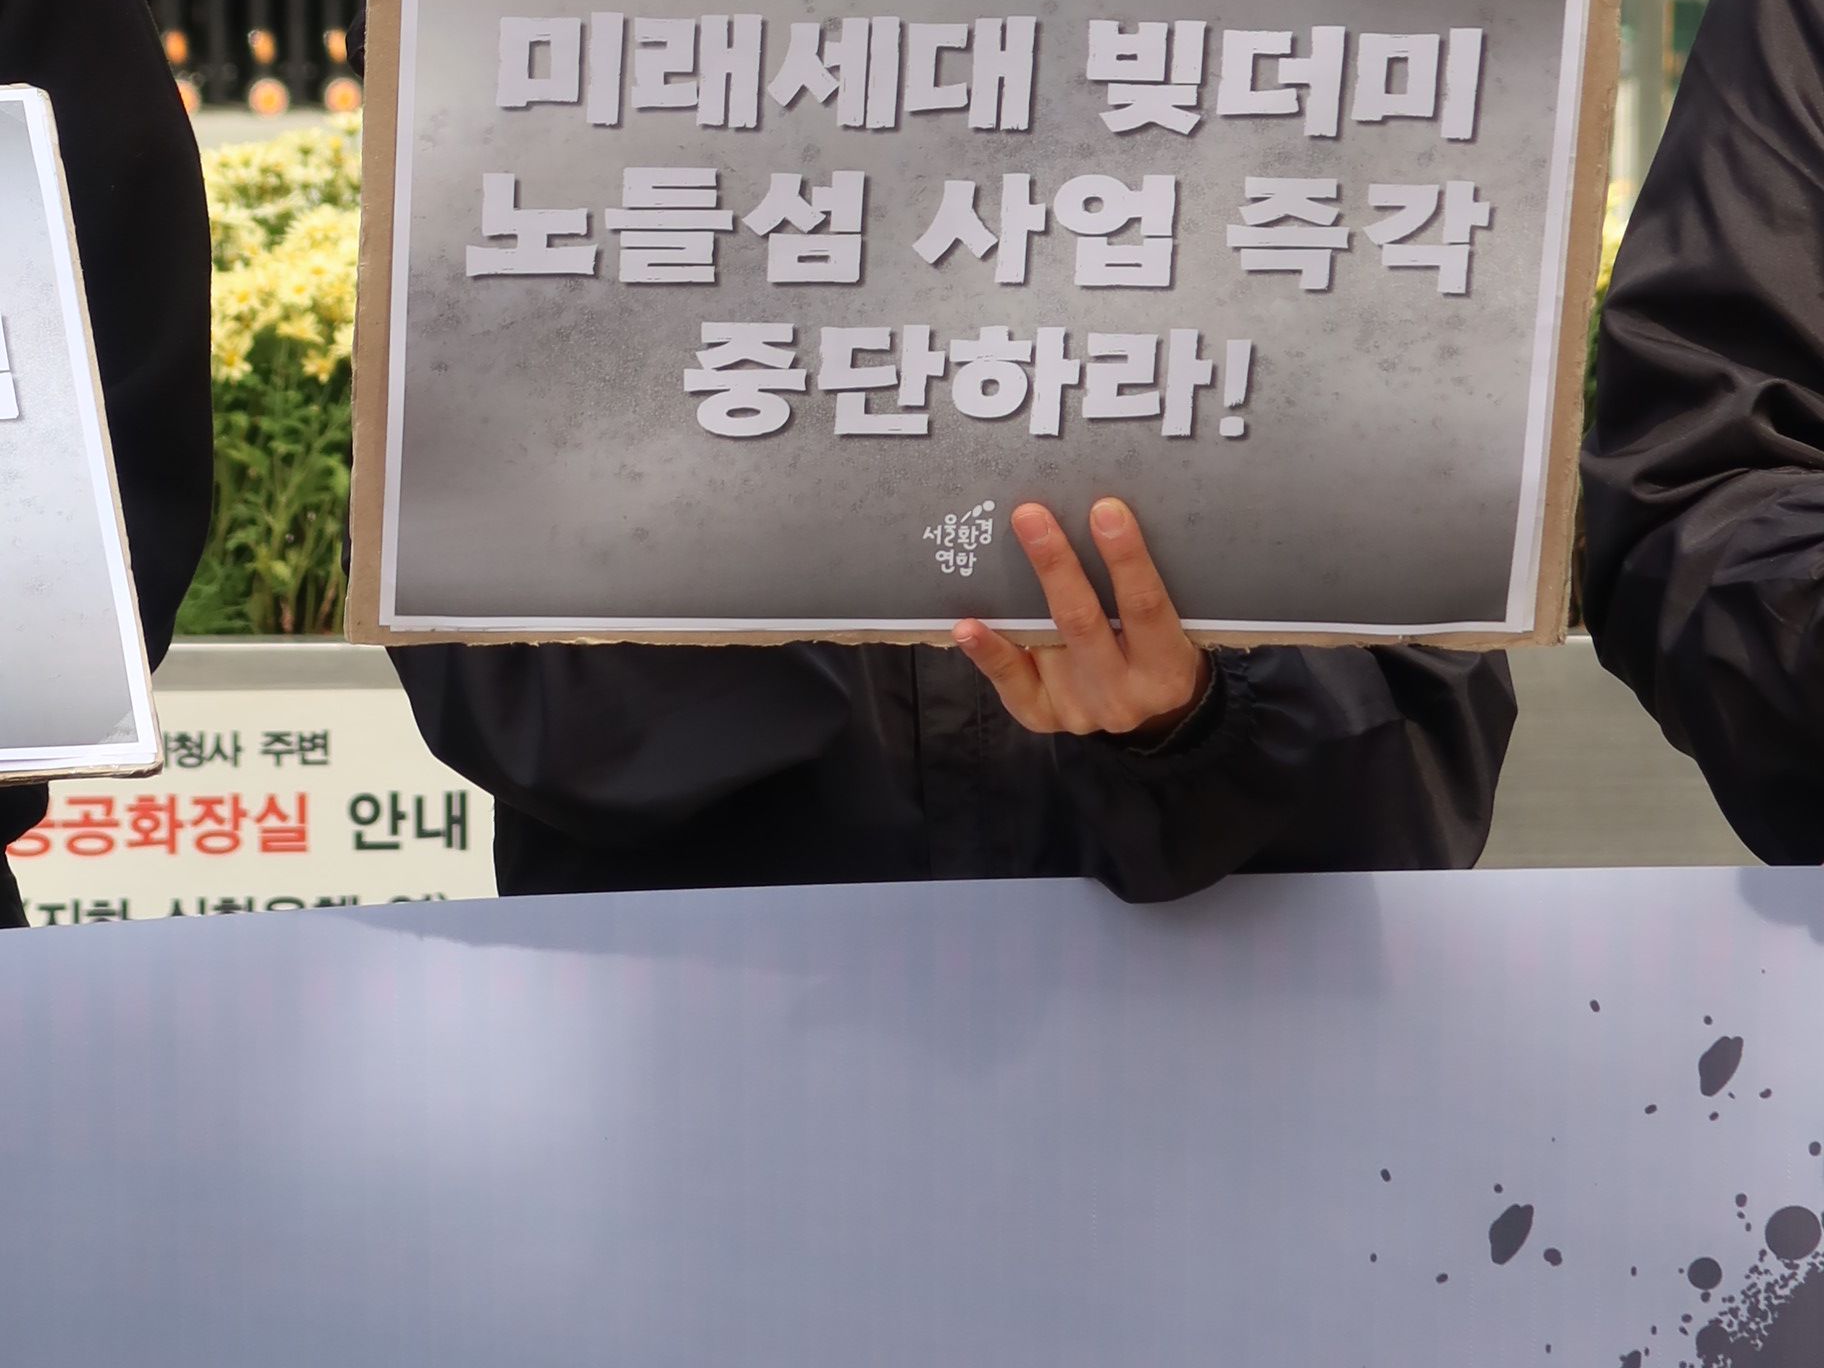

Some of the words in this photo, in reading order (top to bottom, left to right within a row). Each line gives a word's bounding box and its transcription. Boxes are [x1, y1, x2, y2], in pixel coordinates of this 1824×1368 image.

[496, 12, 1038, 132] 미래세대
[1086, 19, 1483, 140] 빚더미
[465, 167, 866, 284] 노들섬
[911, 172, 1176, 288] 사업
[1226, 176, 1491, 294] 즉각
[683, 321, 1253, 438] 중단하라!
[923, 514, 993, 550] 서울환경
[935, 549, 977, 576] 연합
[161, 730, 243, 769] 청사
[259, 729, 330, 767] 주변
[348, 789, 469, 852] 안내
